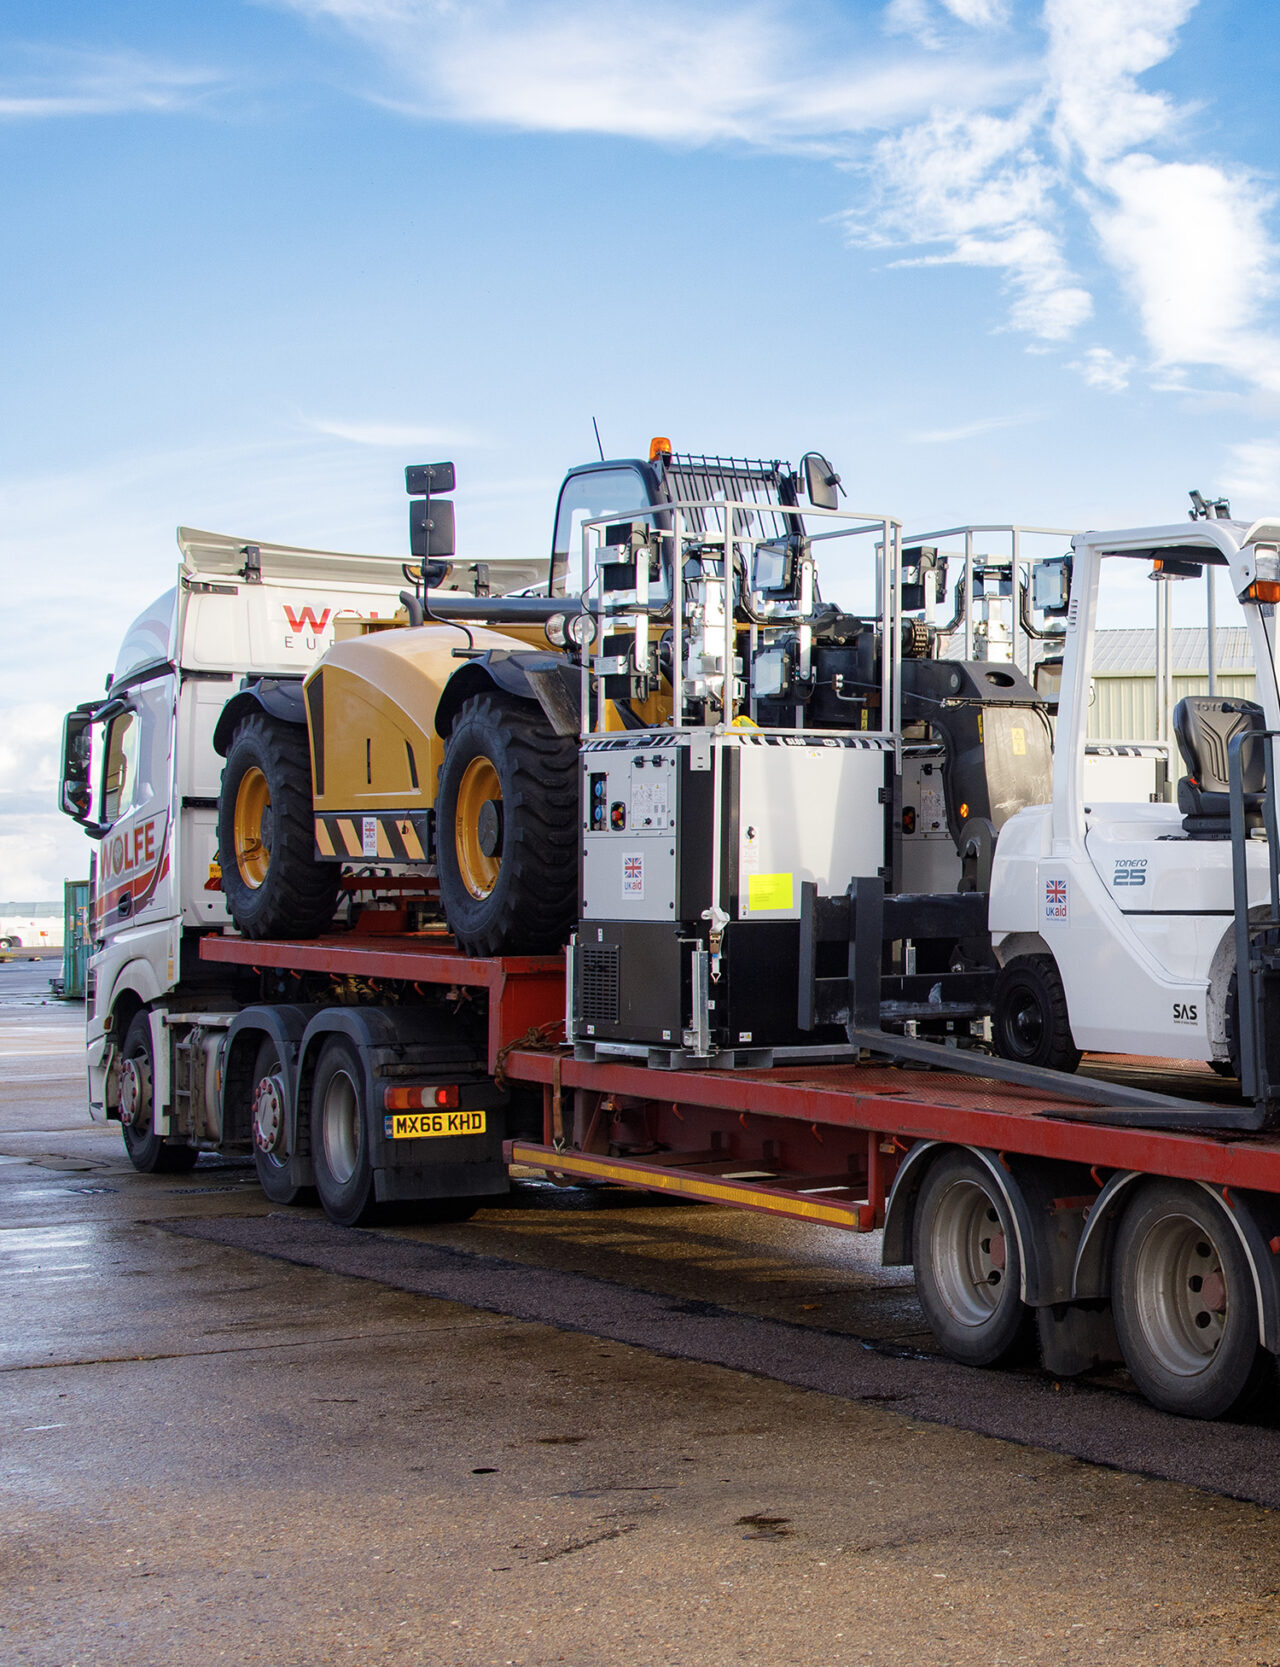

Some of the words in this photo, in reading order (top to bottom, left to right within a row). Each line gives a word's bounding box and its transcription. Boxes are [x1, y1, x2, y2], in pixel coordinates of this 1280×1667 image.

[100, 820, 155, 882] WOLFE
[1113, 869, 1146, 886] 25
[1173, 1003, 1198, 1020] SAS
[396, 1115, 443, 1134] MX66
[448, 1112, 482, 1131] KHD
